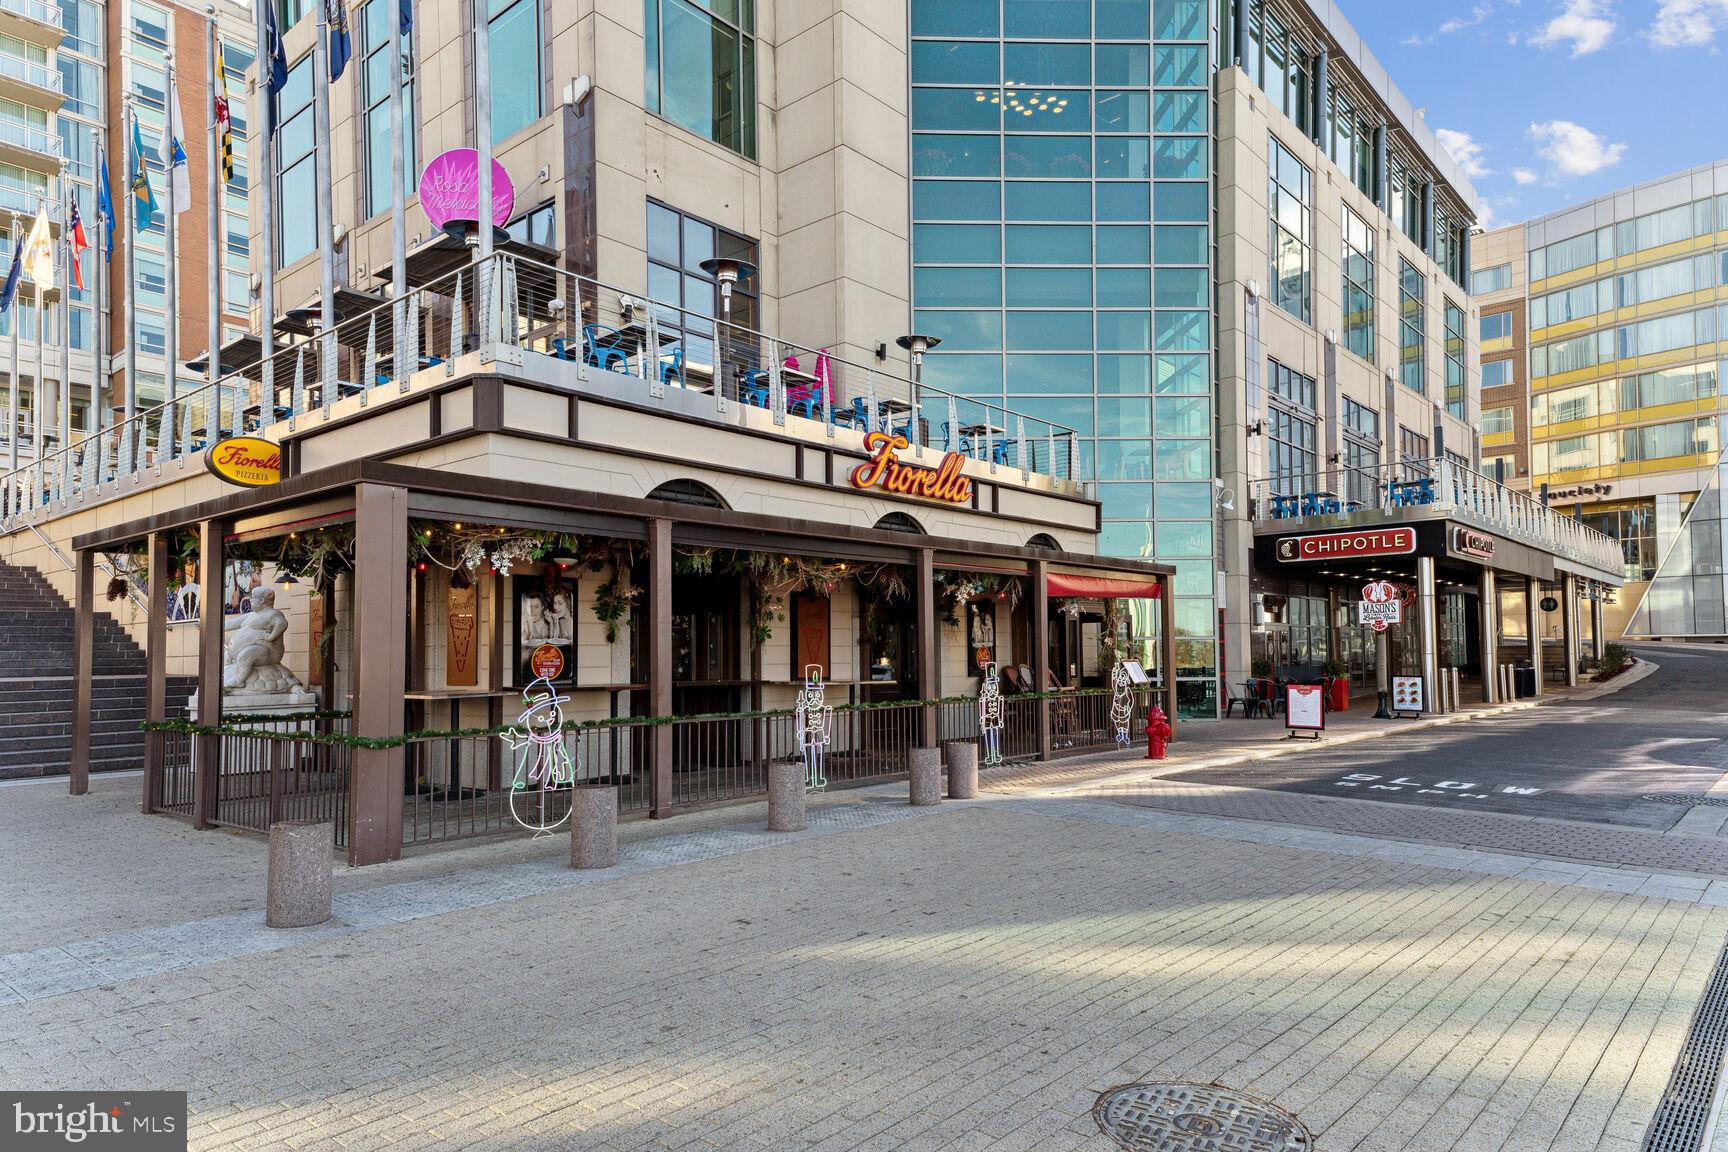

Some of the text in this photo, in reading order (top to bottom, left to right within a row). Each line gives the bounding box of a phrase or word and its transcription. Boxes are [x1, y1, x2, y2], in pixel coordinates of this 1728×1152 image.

[432, 175, 469, 193] Rosa
[427, 190, 504, 212] Mexicao
[236, 469, 269, 482] PIZZERIA
[851, 431, 974, 503] Fiorella
[1539, 483, 1612, 500] auciety
[1304, 533, 1406, 554] CHIPOTLE
[1362, 603, 1397, 614] MASON'S
[1342, 773, 1541, 796] SLOW
